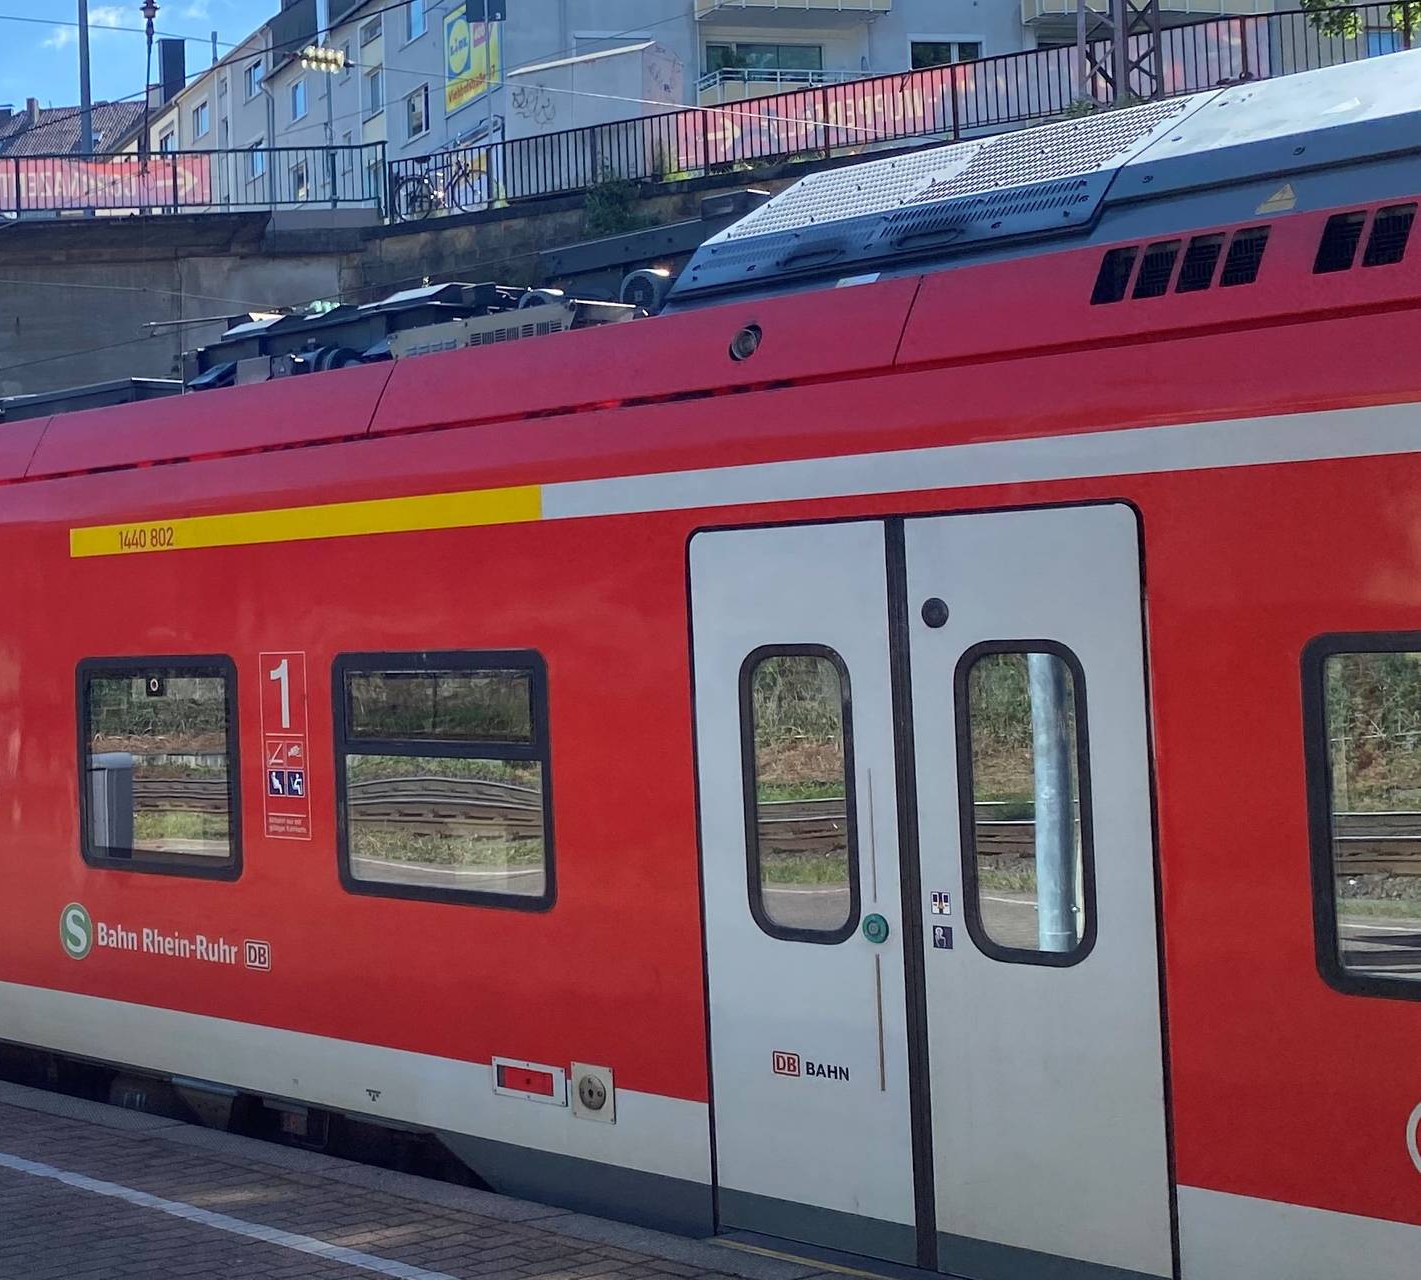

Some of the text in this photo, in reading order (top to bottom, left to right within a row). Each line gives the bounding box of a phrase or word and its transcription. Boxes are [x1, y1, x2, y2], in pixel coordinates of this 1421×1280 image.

[118, 526, 175, 550] 1440 802
[268, 658, 291, 730] 1
[65, 908, 268, 968] S Bahn Rhein-Ruhr DB
[775, 1053, 850, 1082] DB BAHN
